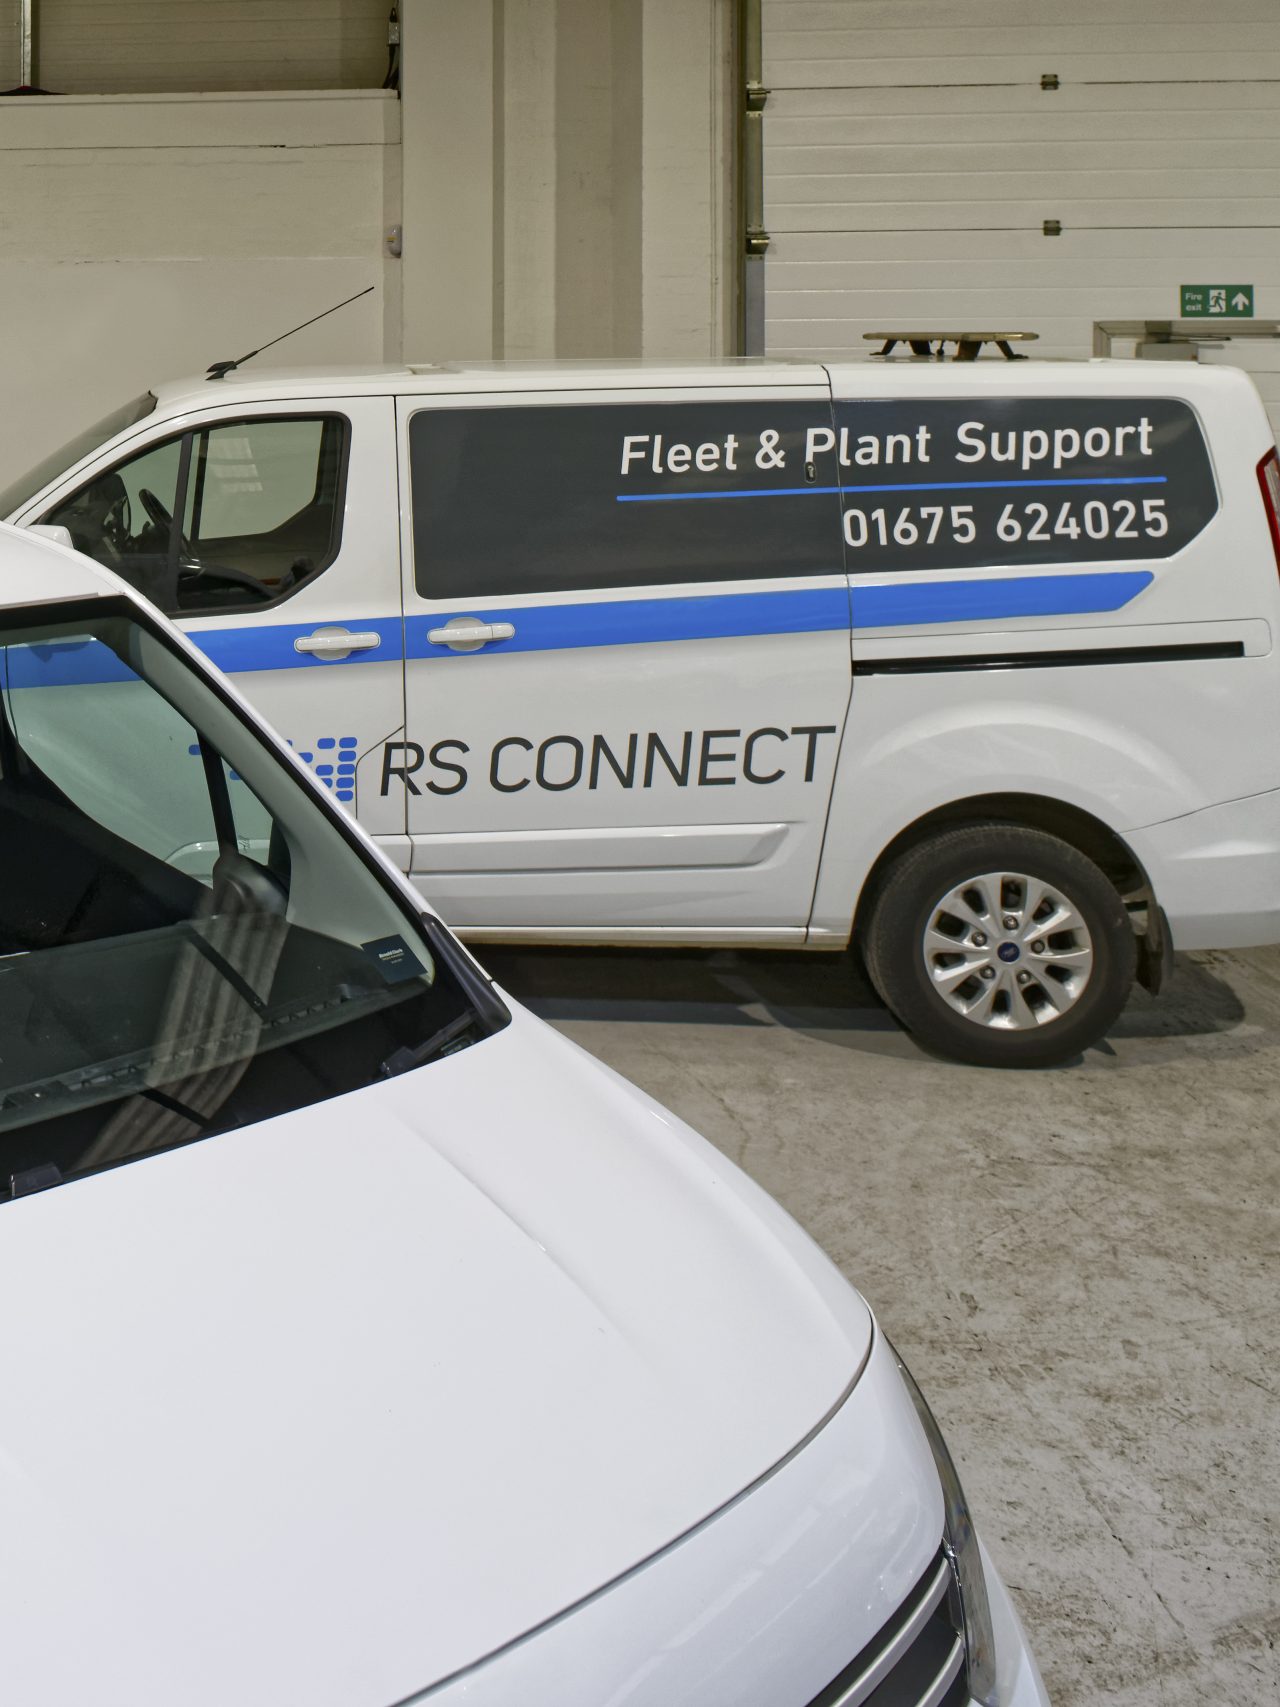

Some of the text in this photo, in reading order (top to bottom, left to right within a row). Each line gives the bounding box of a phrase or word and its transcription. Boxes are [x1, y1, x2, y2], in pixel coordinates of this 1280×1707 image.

[1185, 292, 1202, 301] Fire
[620, 417, 1153, 475] Fleet & Plant Support
[843, 499, 1168, 547] 01675 624025
[380, 725, 837, 797] RS CONNECT
